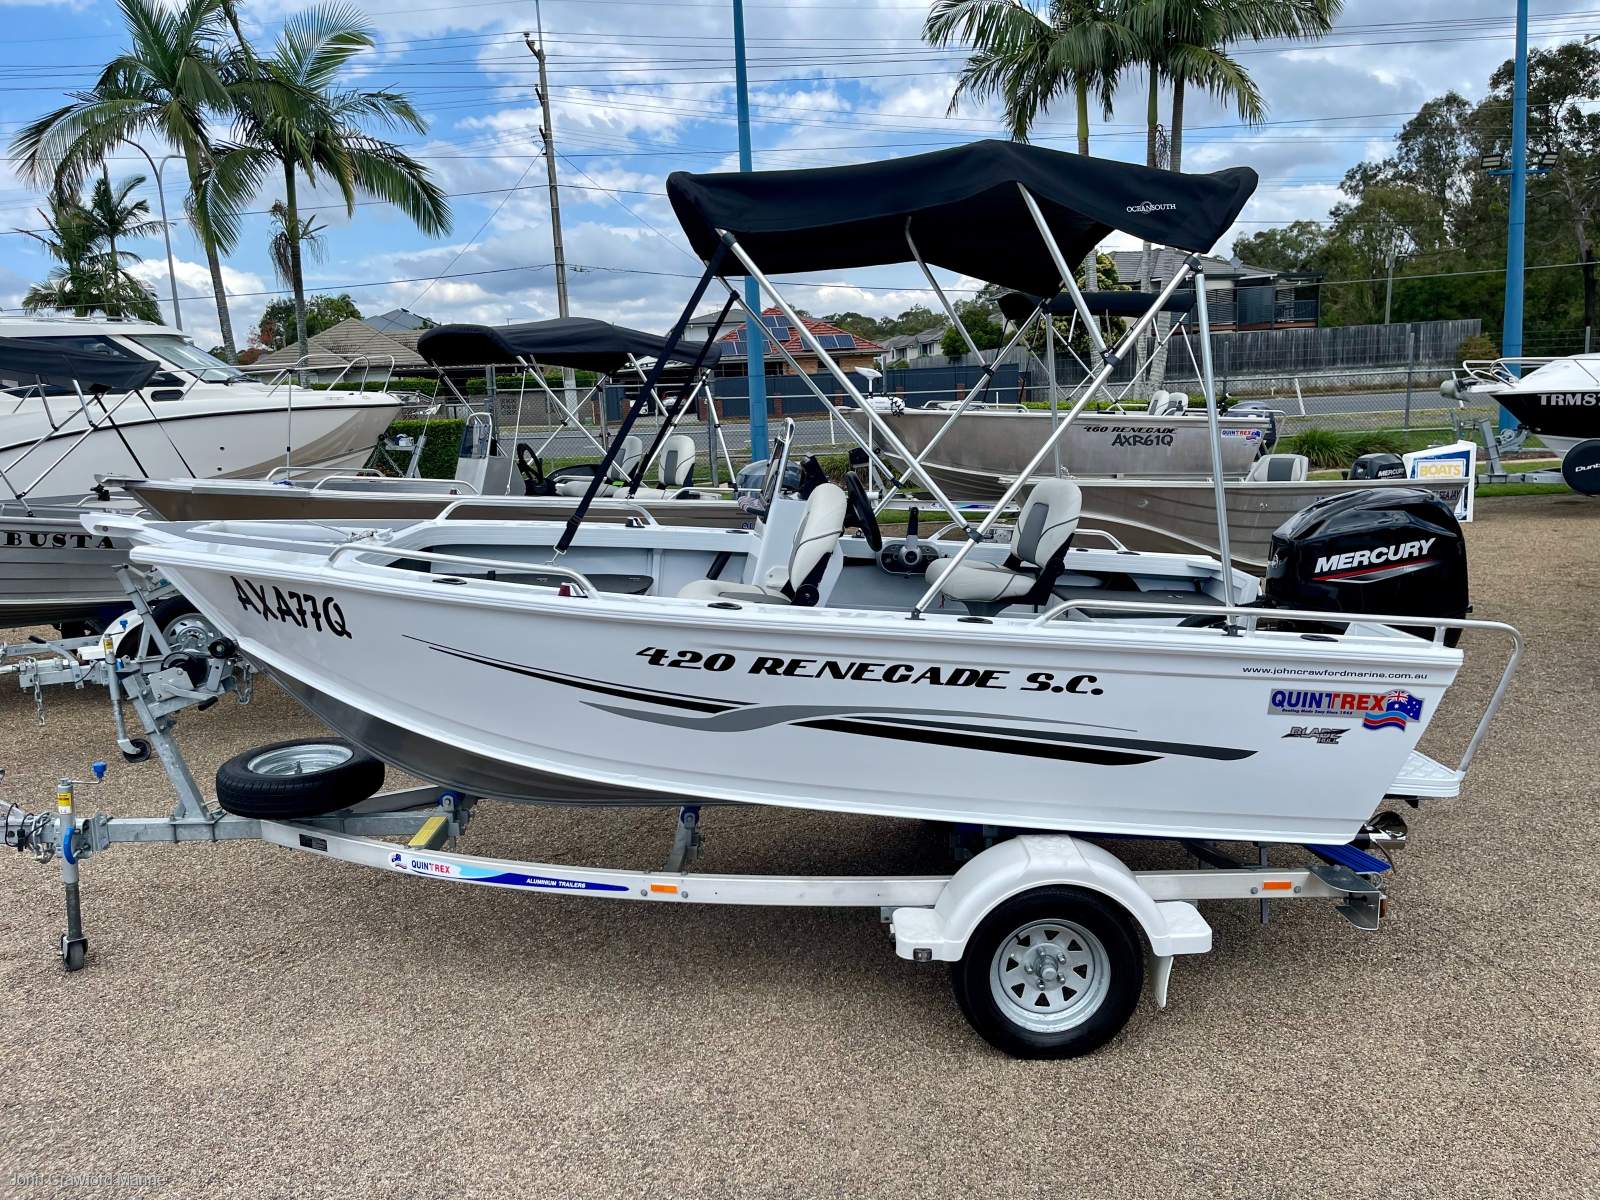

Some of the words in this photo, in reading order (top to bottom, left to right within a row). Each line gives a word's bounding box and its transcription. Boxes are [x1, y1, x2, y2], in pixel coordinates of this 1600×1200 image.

[1126, 203, 1177, 213] OCEANSOUTH
[1537, 393, 1600, 406] TRM8
[1111, 426, 1178, 434] RENEGADE
[1112, 433, 1174, 447] AXR61Q
[1419, 464, 1461, 476] BOATS
[3, 531, 117, 549] BUSTA
[1314, 537, 1437, 574] MERCURY
[229, 575, 353, 639] AXA77Q
[635, 646, 736, 672] 420
[747, 656, 1011, 690] RENEGADE
[1020, 672, 1104, 696] S.C.
[1242, 666, 1428, 680] www.johncrawfordmarine.com.au
[1271, 690, 1387, 712] QUINTREX
[411, 860, 450, 874] QUINTREX
[526, 877, 557, 887] ALUMINIUM
[558, 880, 587, 888] TRAILERS
